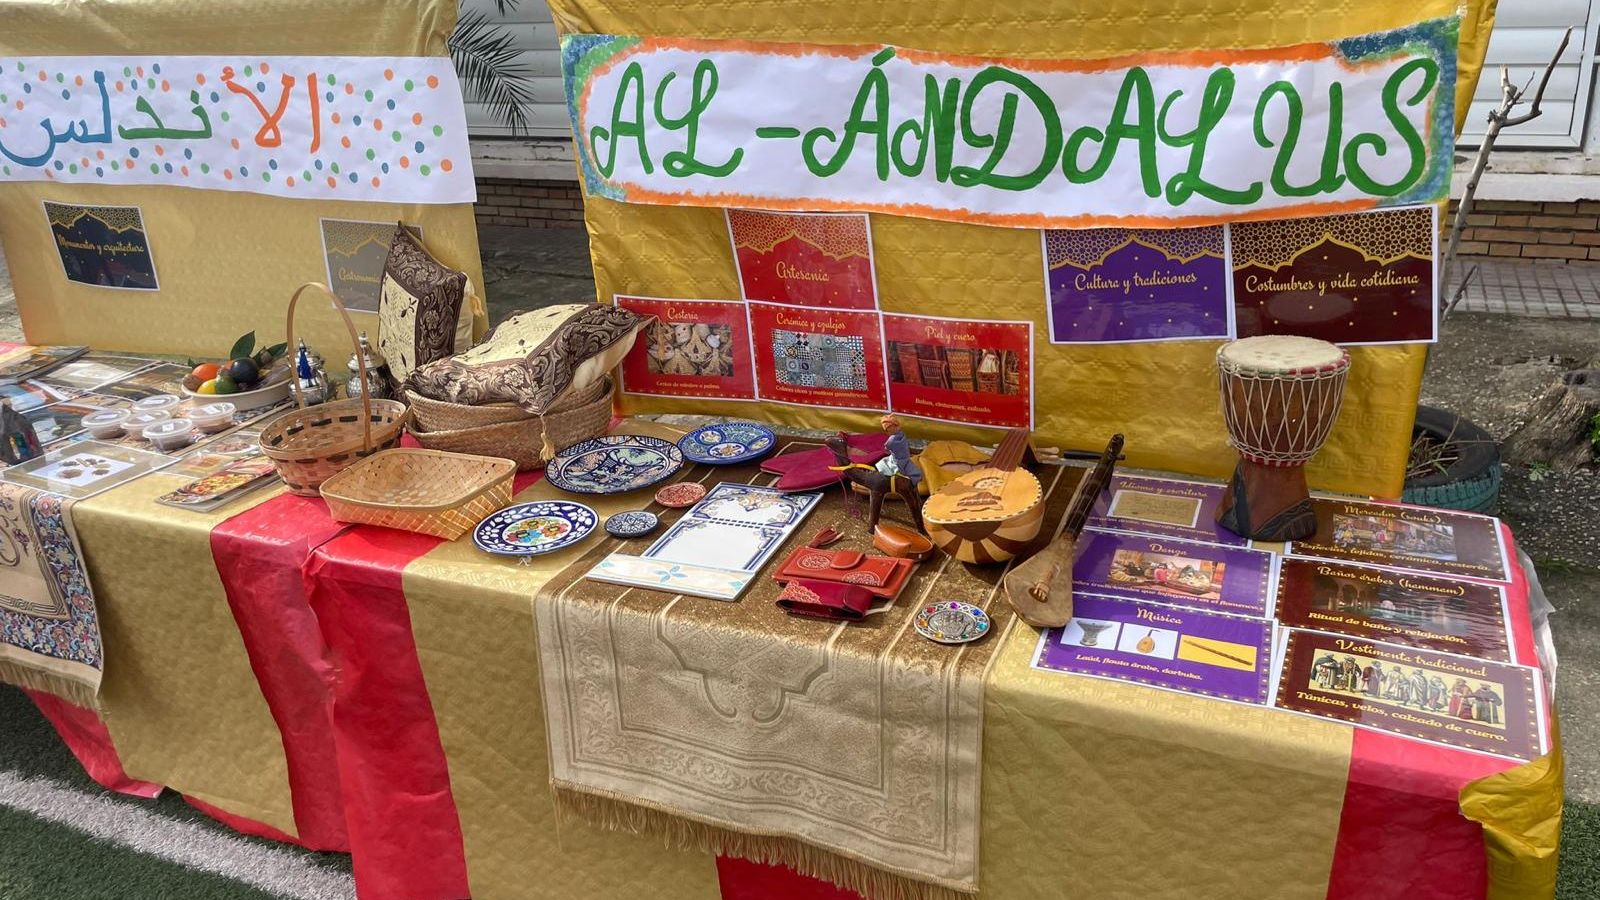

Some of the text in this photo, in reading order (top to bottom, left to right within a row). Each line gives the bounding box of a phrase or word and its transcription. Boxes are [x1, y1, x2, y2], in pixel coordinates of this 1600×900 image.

[1074, 269, 1198, 295] Cultura y tradiciones
[1245, 269, 1420, 297] Costumbres y vida cotidiana
[810, 320, 816, 332] y
[817, 316, 847, 334] azulejos
[924, 325, 976, 345] Piel y cuero
[1344, 505, 1396, 518] Mercados
[1148, 543, 1188, 558] Danza
[1299, 541, 1347, 555] Especias,
[1350, 547, 1387, 559] tejidos,
[1389, 554, 1442, 567] cerámica,
[1316, 566, 1466, 597] Baños árabes (hammam)
[1136, 607, 1183, 625] Música
[1308, 611, 1343, 623] Ritual
[1345, 616, 1360, 625] de
[1362, 620, 1392, 632] baño
[1403, 629, 1468, 645] relajación.
[1076, 654, 1203, 681] Laúd, flauta árabe, darbuka.
[1336, 639, 1489, 678] Vestimenta tradicional
[1296, 690, 1508, 742] Túnicas, velos, calzado de cuero.
